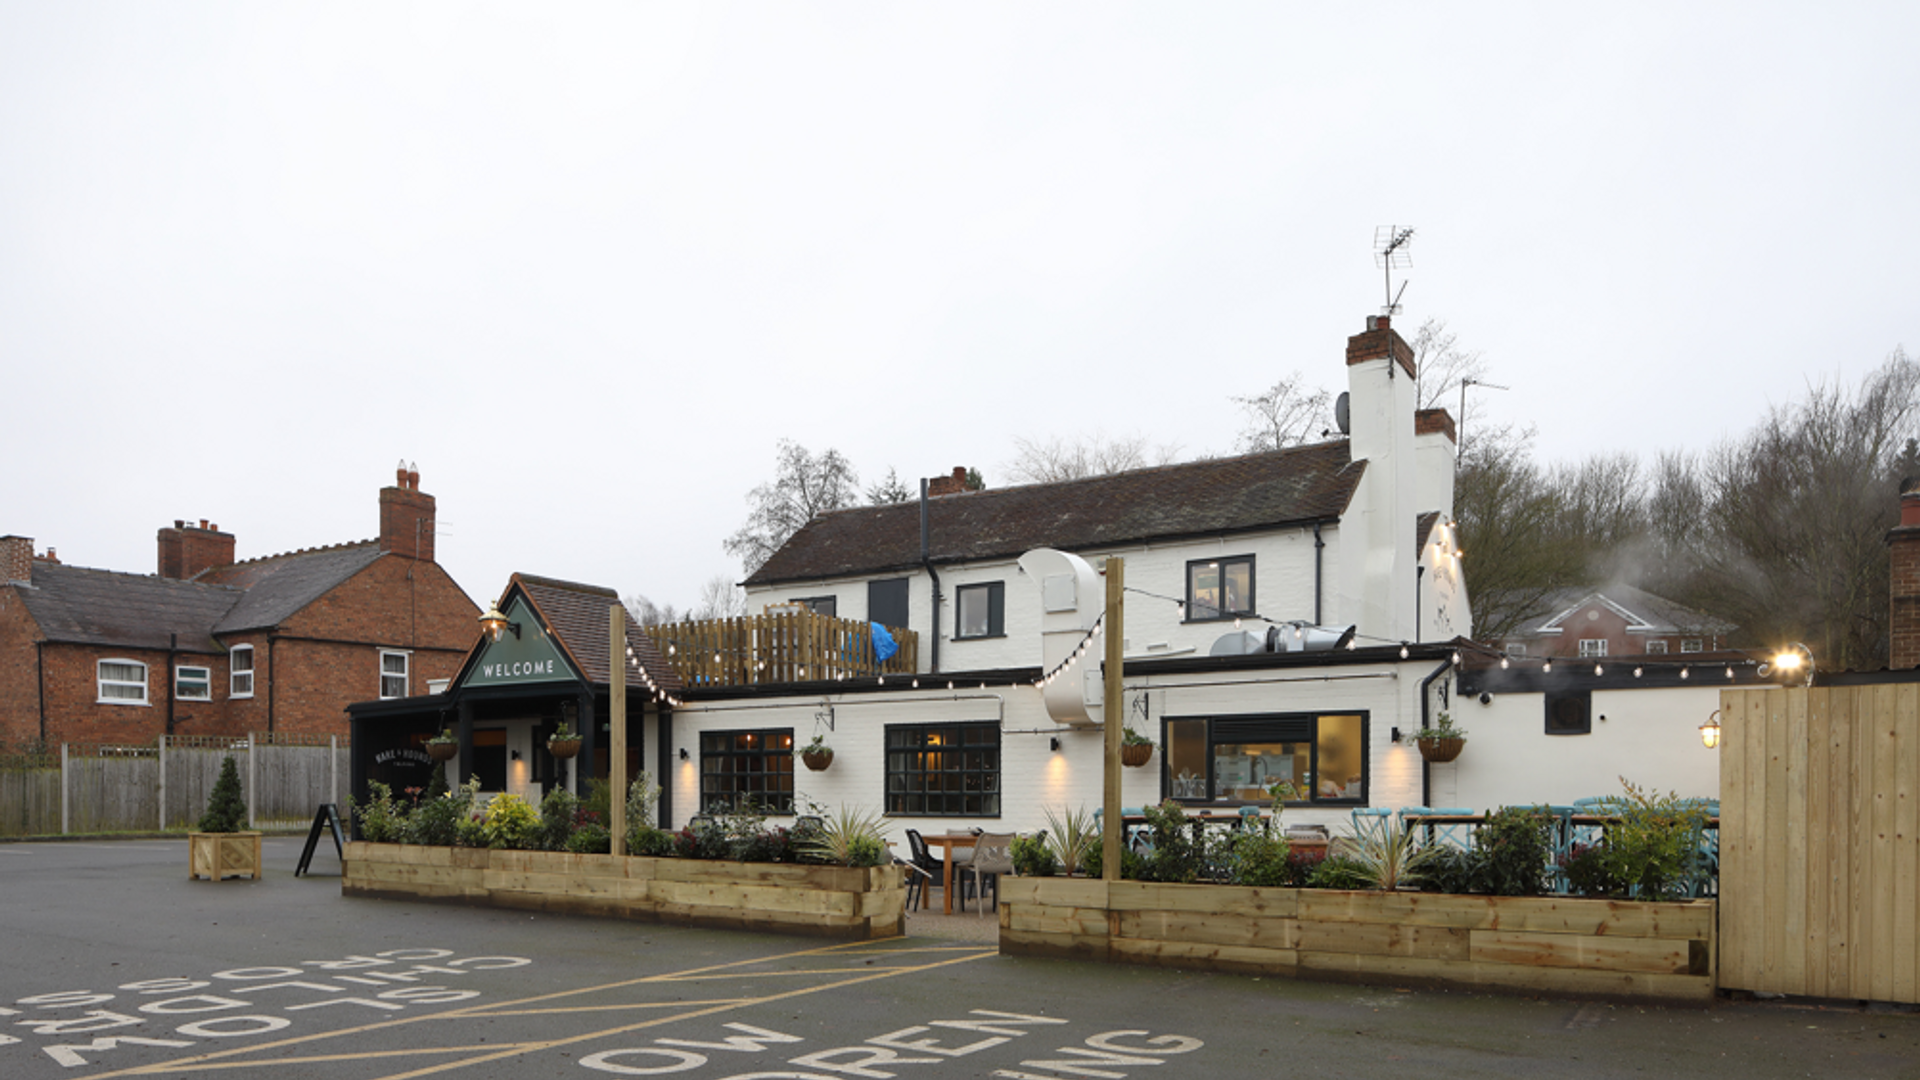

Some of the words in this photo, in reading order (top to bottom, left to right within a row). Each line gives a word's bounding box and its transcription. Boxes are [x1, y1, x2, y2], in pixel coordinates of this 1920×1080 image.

[482, 659, 554, 678] WELCOME
[0, 947, 454, 1017] CROSS
[0, 955, 532, 1047] CHILDR
[41, 986, 481, 1067] SLOW
